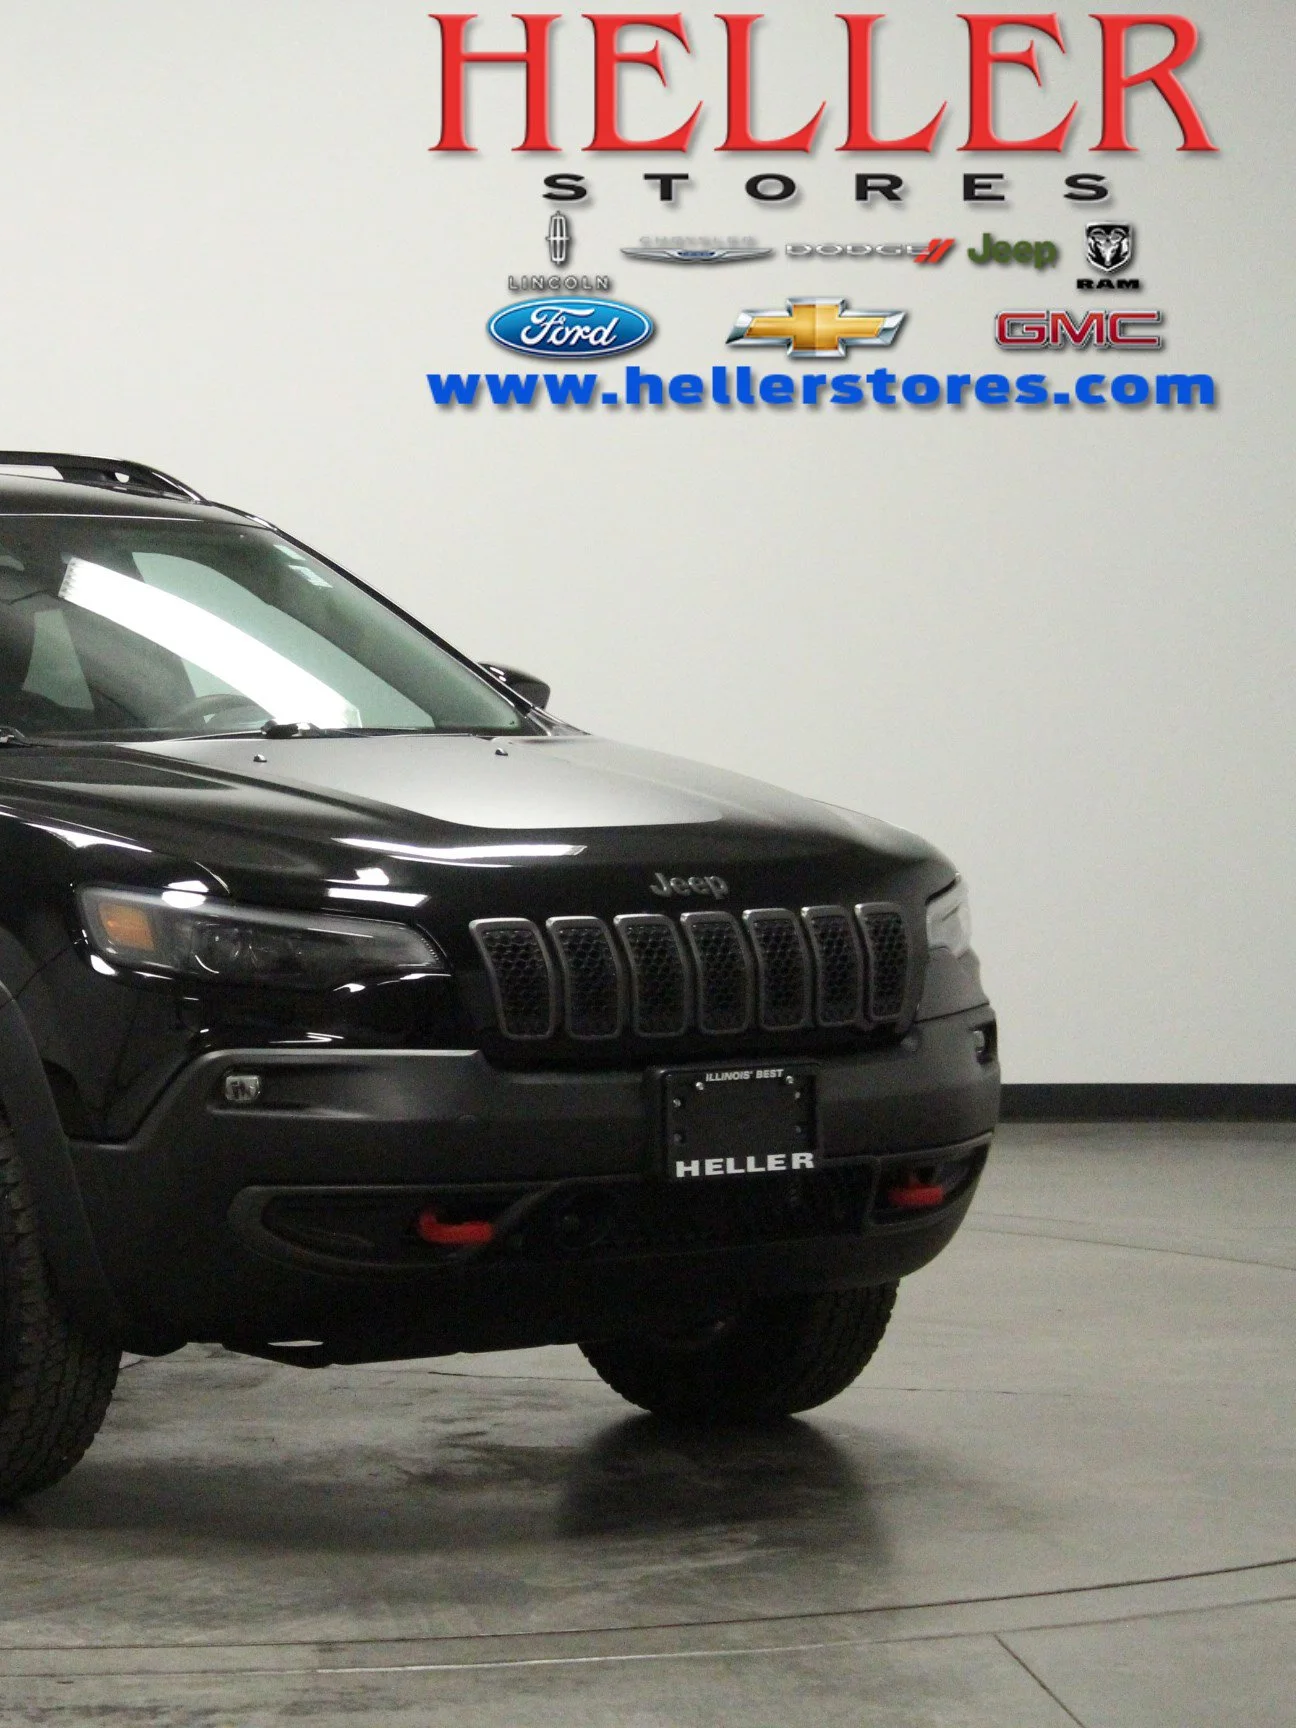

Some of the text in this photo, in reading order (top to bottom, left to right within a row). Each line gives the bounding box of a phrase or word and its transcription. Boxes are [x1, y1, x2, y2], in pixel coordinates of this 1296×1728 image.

[650, 872, 729, 900] Jeep
[756, 1068, 785, 1080] BEST
[675, 1152, 814, 1178] HELLER
